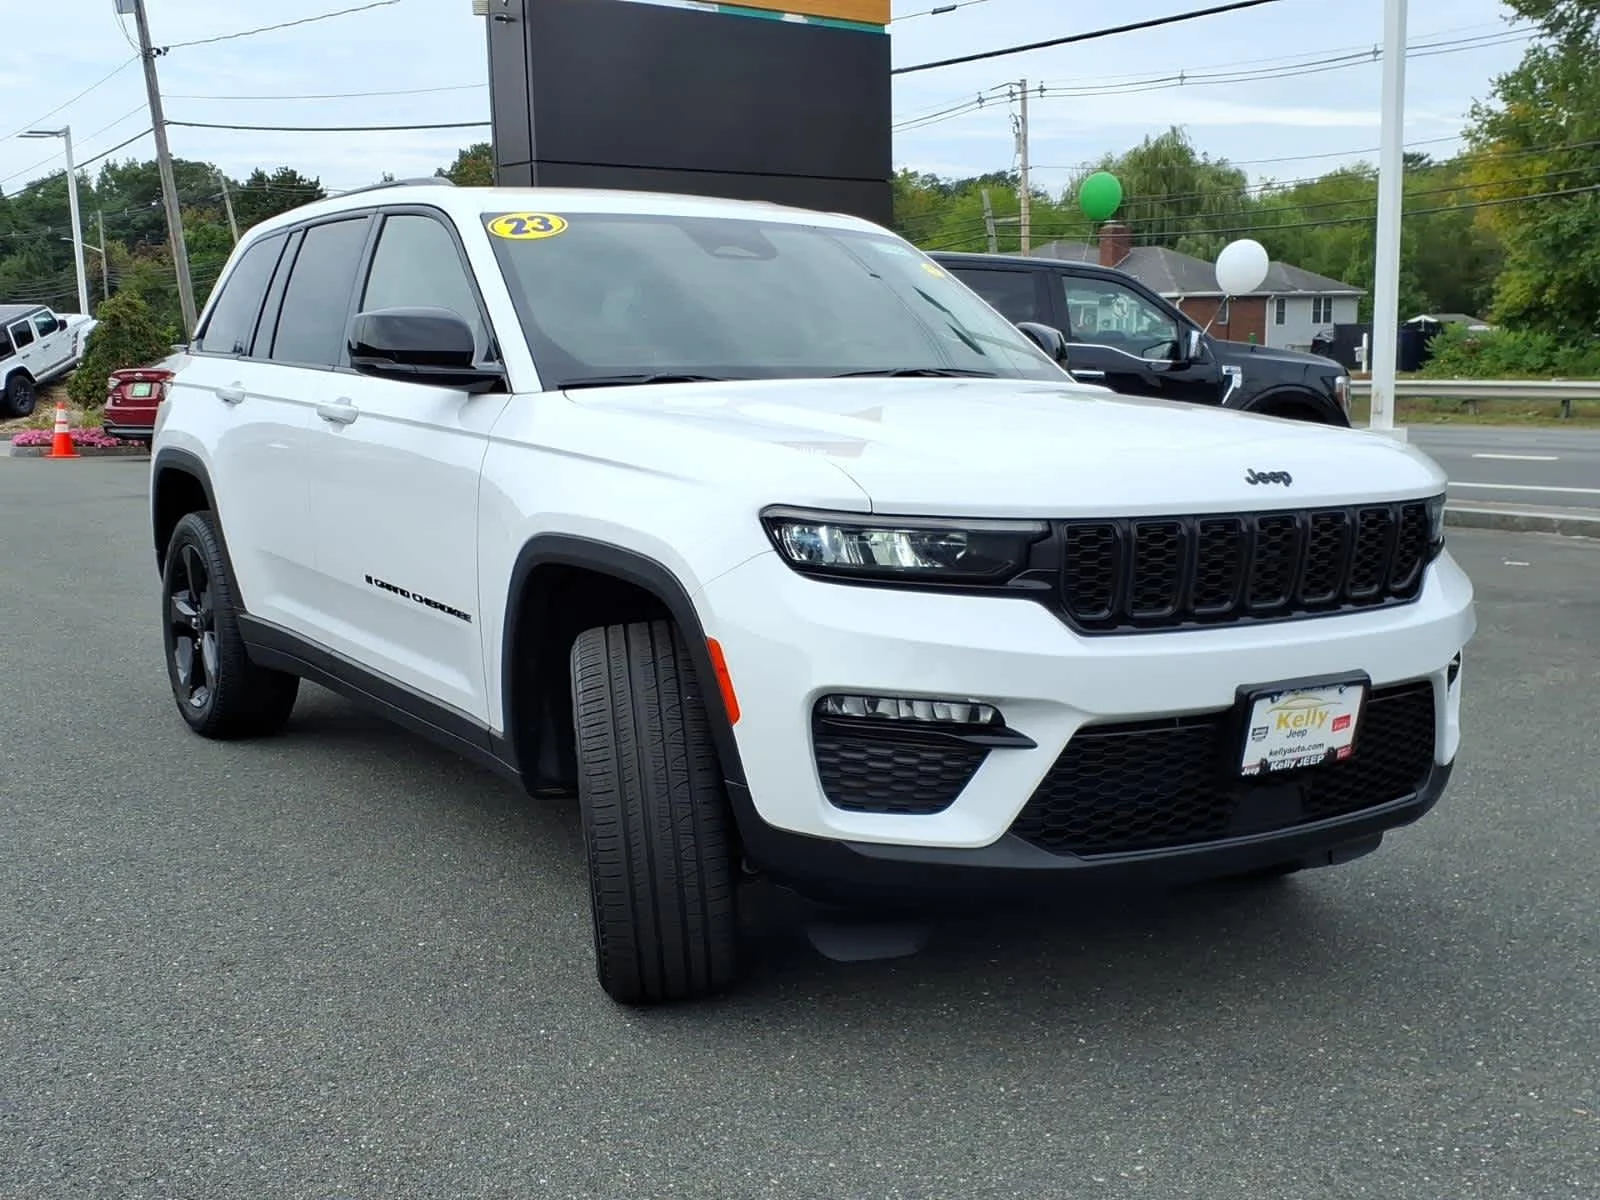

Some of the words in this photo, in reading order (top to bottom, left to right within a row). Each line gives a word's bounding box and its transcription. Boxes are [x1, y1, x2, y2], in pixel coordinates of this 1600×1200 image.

[504, 215, 553, 234] 23
[1245, 468, 1292, 487] Jeep
[374, 579, 411, 599] GRAND
[412, 593, 472, 624] CHEROKEE
[1276, 709, 1328, 730] Kelly
[1286, 728, 1308, 739] Jeep
[1269, 743, 1324, 757] kellyauto.com
